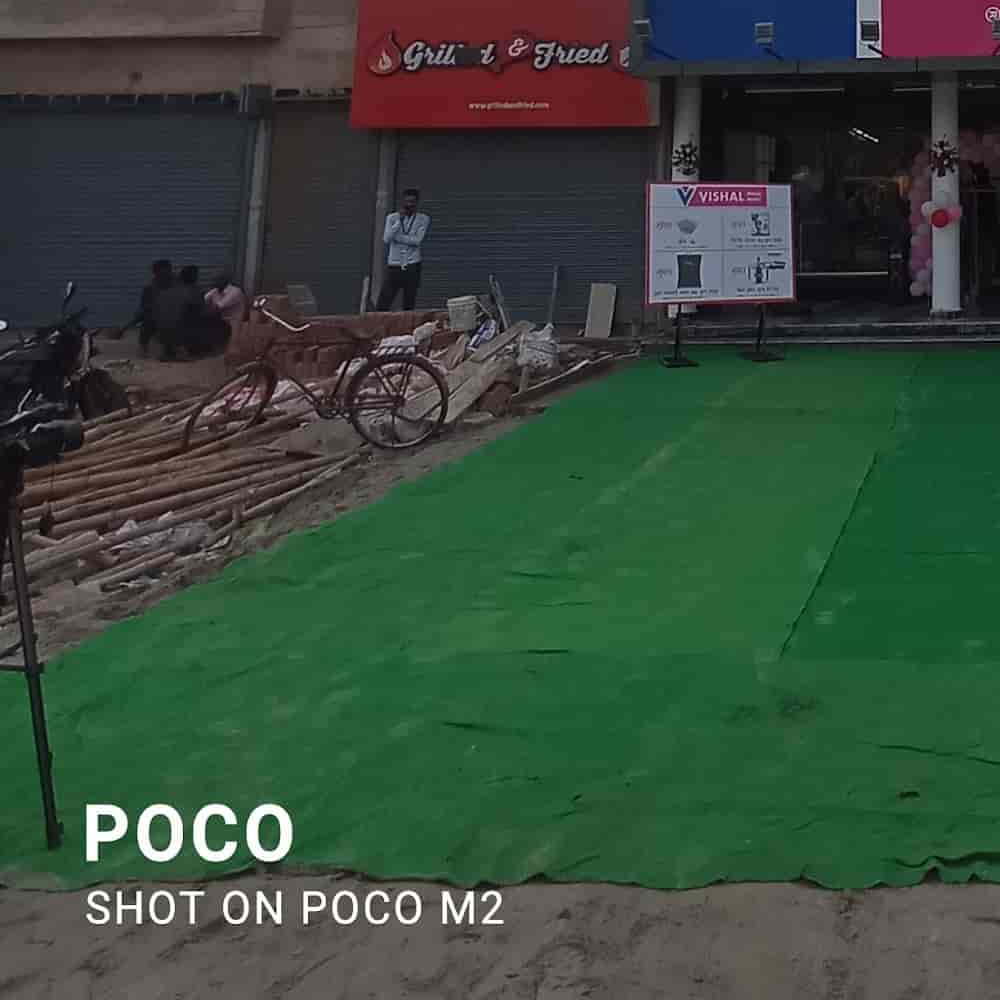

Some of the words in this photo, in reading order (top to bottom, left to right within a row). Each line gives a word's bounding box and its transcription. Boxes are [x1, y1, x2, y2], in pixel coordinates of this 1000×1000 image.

[508, 38, 529, 57] &
[534, 42, 609, 70] Fried
[700, 191, 745, 202] VISHAL
